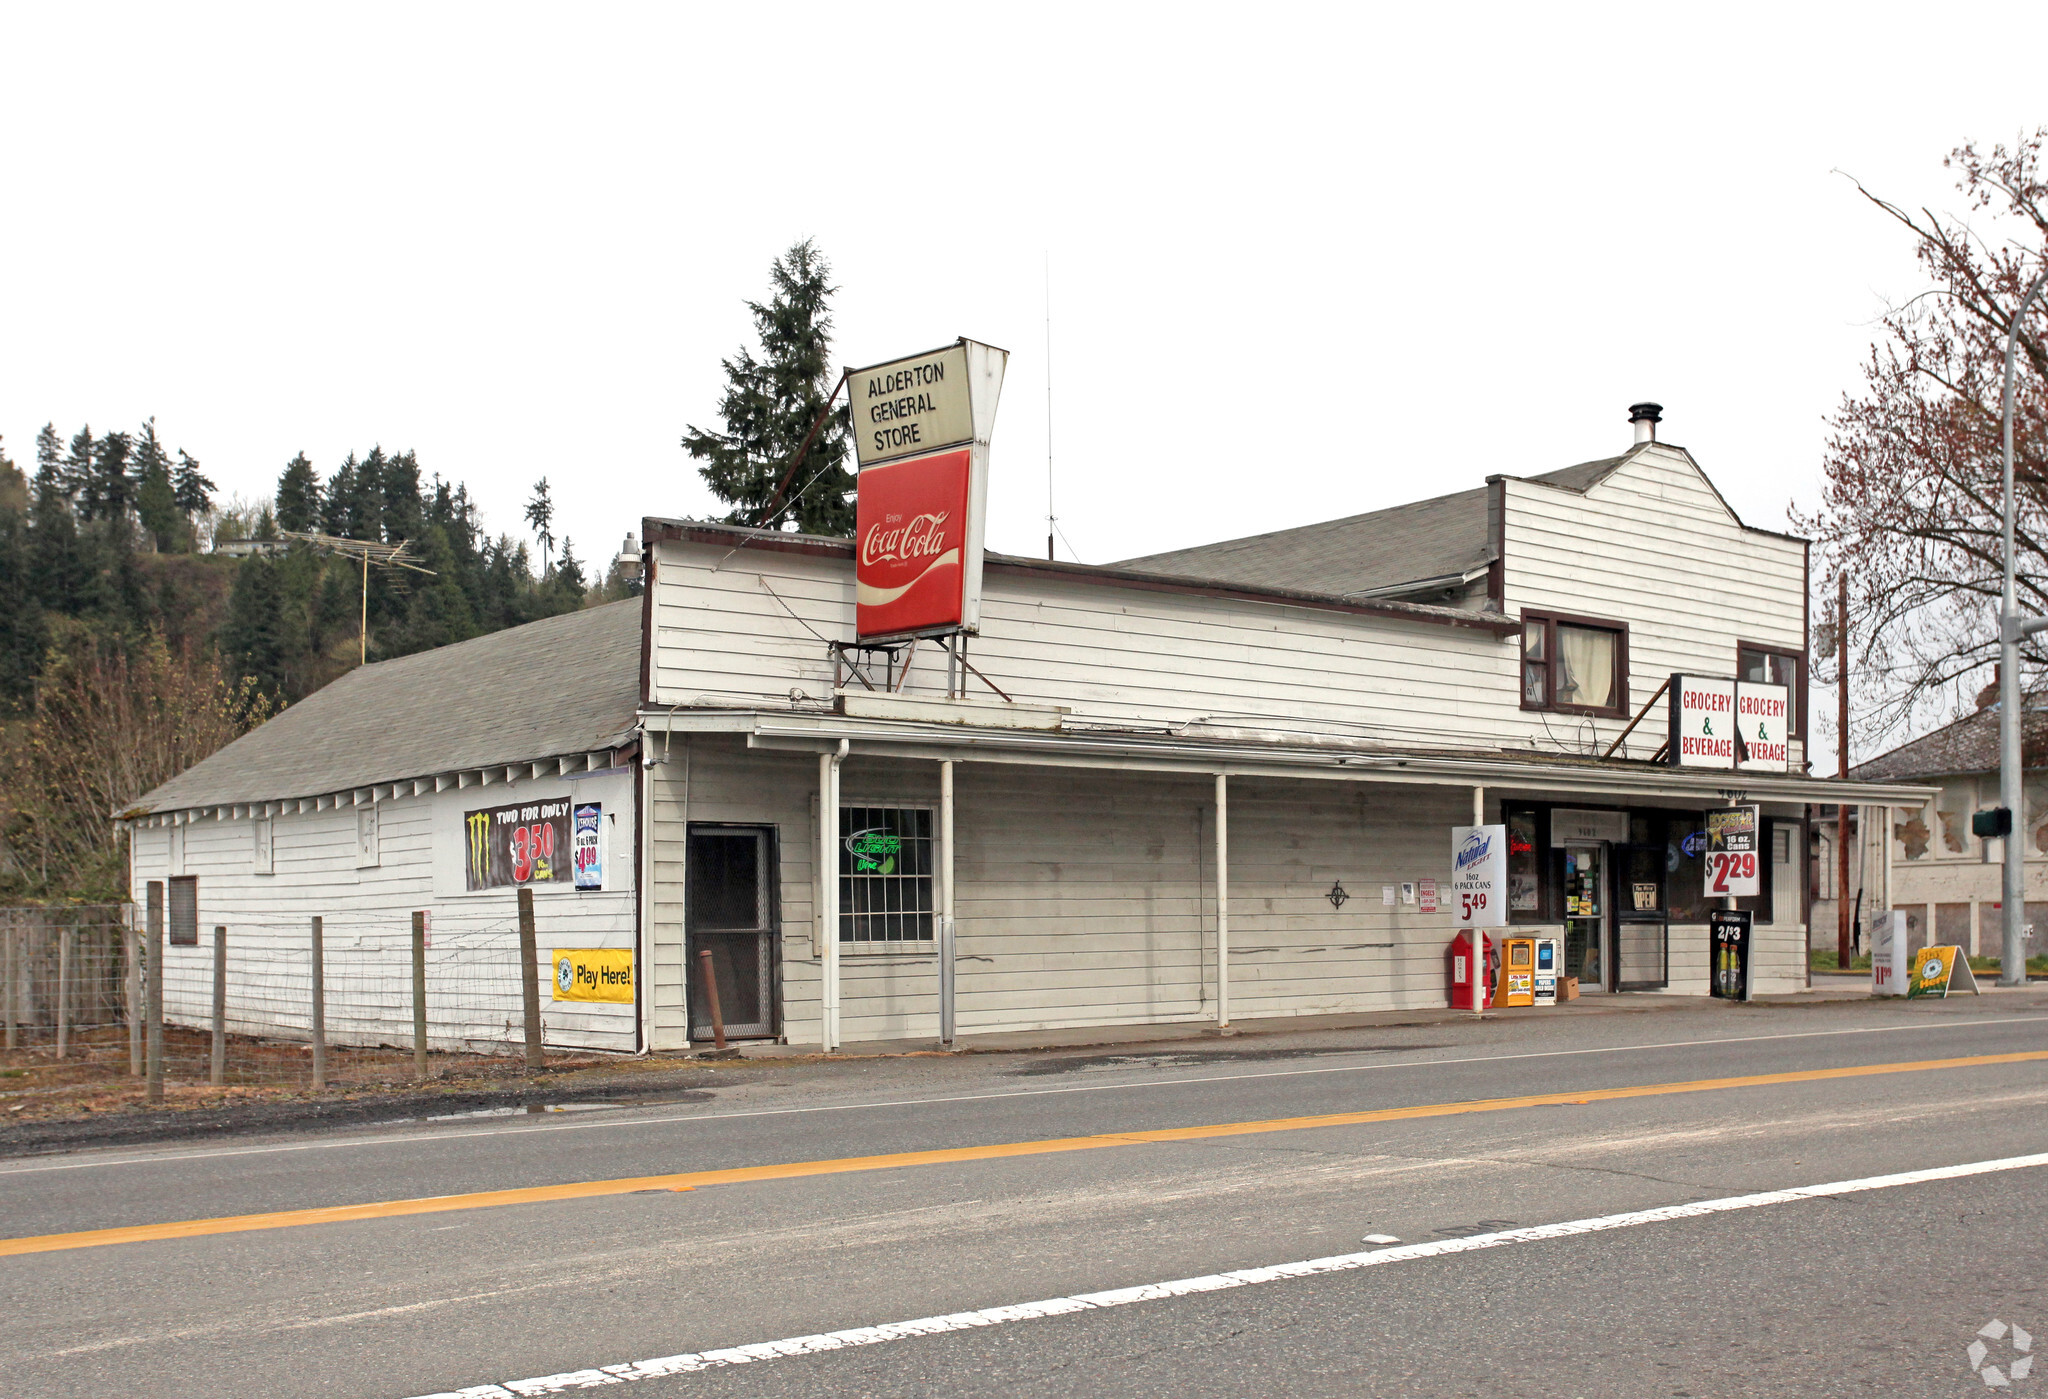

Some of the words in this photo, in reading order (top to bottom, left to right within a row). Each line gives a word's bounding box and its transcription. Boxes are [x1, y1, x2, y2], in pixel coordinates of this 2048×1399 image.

[868, 361, 944, 398] ALDERTON
[871, 392, 936, 423] GENERAL
[874, 423, 921, 451] STORE
[886, 513, 902, 523] Enjoy
[1683, 690, 1731, 712] GROCERY
[1739, 696, 1785, 717] GROCERY
[1703, 716, 1713, 736] &
[1758, 721, 1768, 740] &
[1682, 736, 1732, 757] BEVERAGE
[1745, 741, 1786, 761] EVERAGE
[496, 809, 519, 825] TWO
[521, 806, 539, 821] FOR
[541, 802, 569, 819] ONLY
[577, 816, 598, 831] ICEHOUSE
[588, 835, 598, 846] PACK
[854, 842, 901, 854] LIGHT
[863, 833, 899, 845] BUD
[1726, 835, 1736, 843] 16
[1737, 835, 1751, 843] oz.
[1454, 834, 1493, 872] Natural
[1466, 852, 1493, 871] LIGHT
[1454, 881, 1459, 890] 6
[1460, 881, 1474, 889] PACK
[1475, 880, 1491, 890] CANS
[1465, 872, 1480, 881] 16oz
[1634, 891, 1655, 908] OPEN
[1718, 925, 1740, 942] 2/$3
[577, 964, 598, 990] Play
[601, 965, 631, 985] Here!
[1920, 975, 1948, 989] Here
